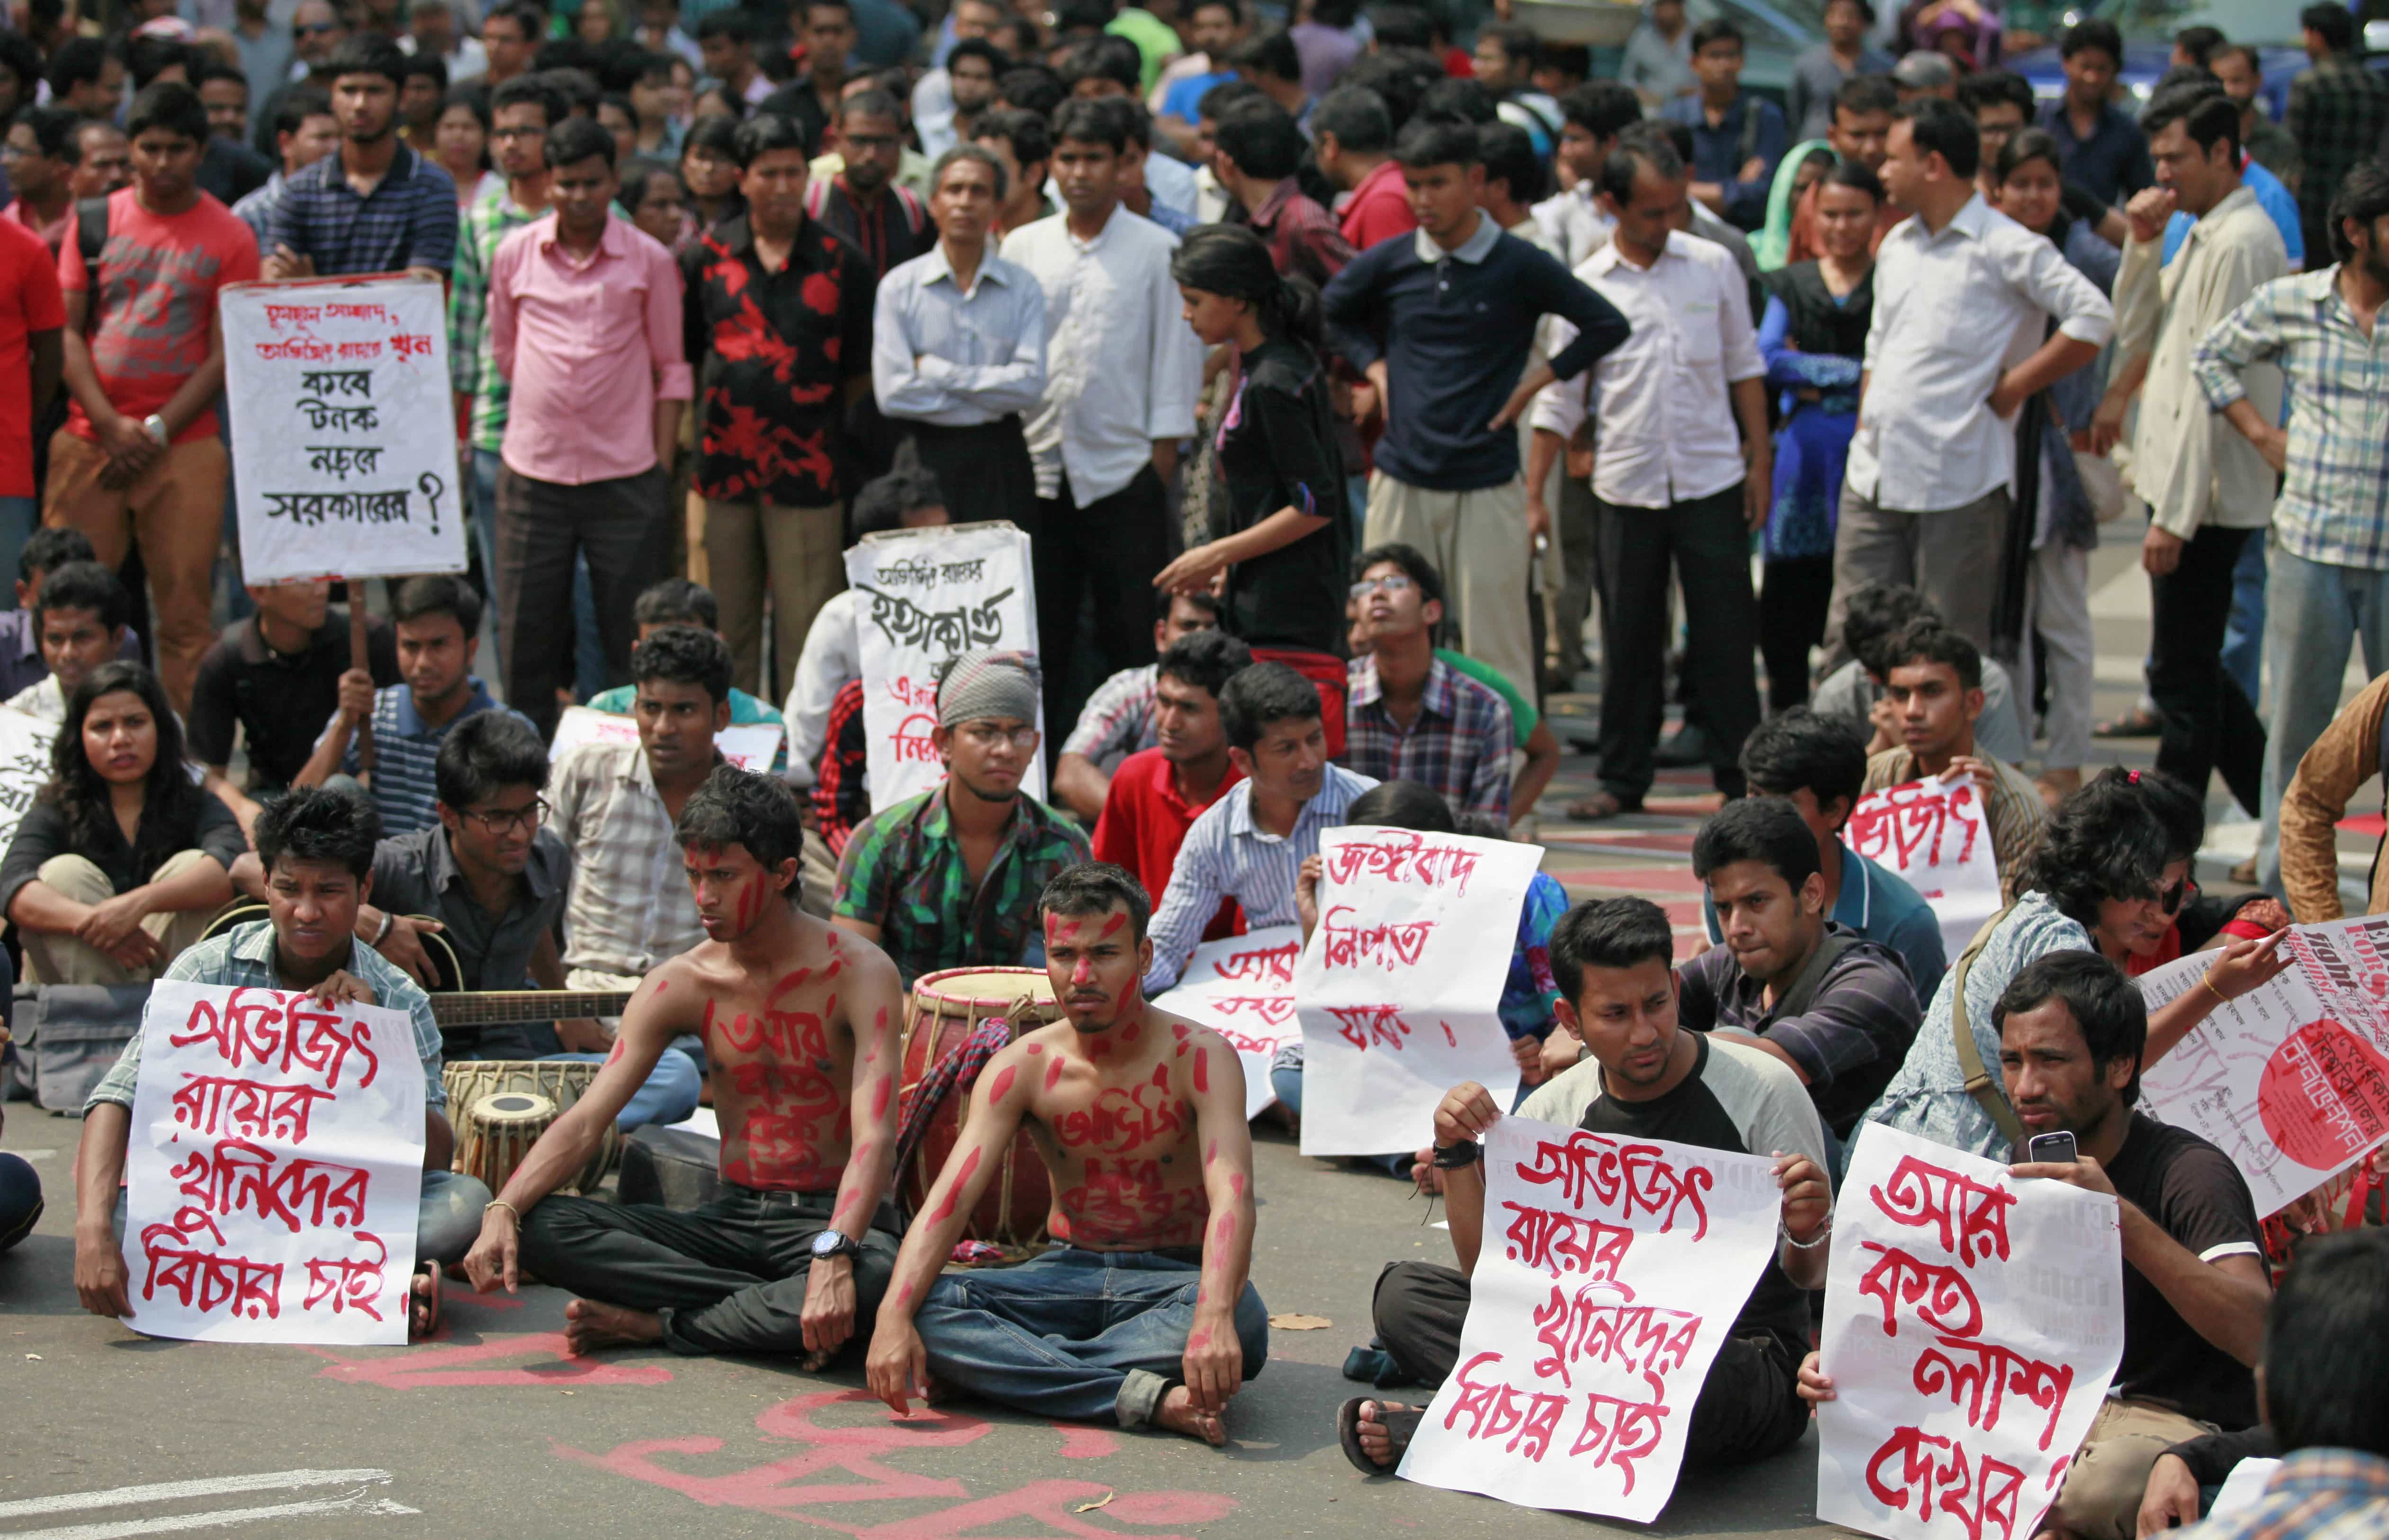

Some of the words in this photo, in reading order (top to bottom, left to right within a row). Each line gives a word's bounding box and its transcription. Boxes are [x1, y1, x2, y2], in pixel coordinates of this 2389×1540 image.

[301, 369, 372, 398] কবে
[389, 331, 432, 364] খুন
[296, 398, 379, 432] টনক
[305, 446, 384, 482] নড়বে
[1212, 940, 1300, 991] আর
[1324, 905, 1439, 971] নিপাত
[2286, 931, 2339, 994] against
[2303, 931, 2359, 989] fight
[170, 986, 377, 1089] অভিজিৎ
[1207, 995, 1295, 1025] কত
[1324, 1003, 1411, 1051] যাক
[173, 1071, 336, 1145] রায়ের
[2280, 1035, 2369, 1154] কনভেনশন
[170, 1137, 372, 1246] খুনিদের
[1516, 1131, 1715, 1242] অভিজিৎ
[1869, 1154, 2018, 1269] আর
[141, 1223, 284, 1320] বিচার
[303, 1231, 387, 1324] চাই
[1501, 1200, 1634, 1282] রায়ের
[1859, 1240, 1983, 1338] কত
[1534, 1280, 1704, 1389] খুনিদের
[1444, 1352, 1571, 1463] বিচার
[1569, 1370, 1671, 1497] চাই
[1913, 1335, 2074, 1452] লাশ
